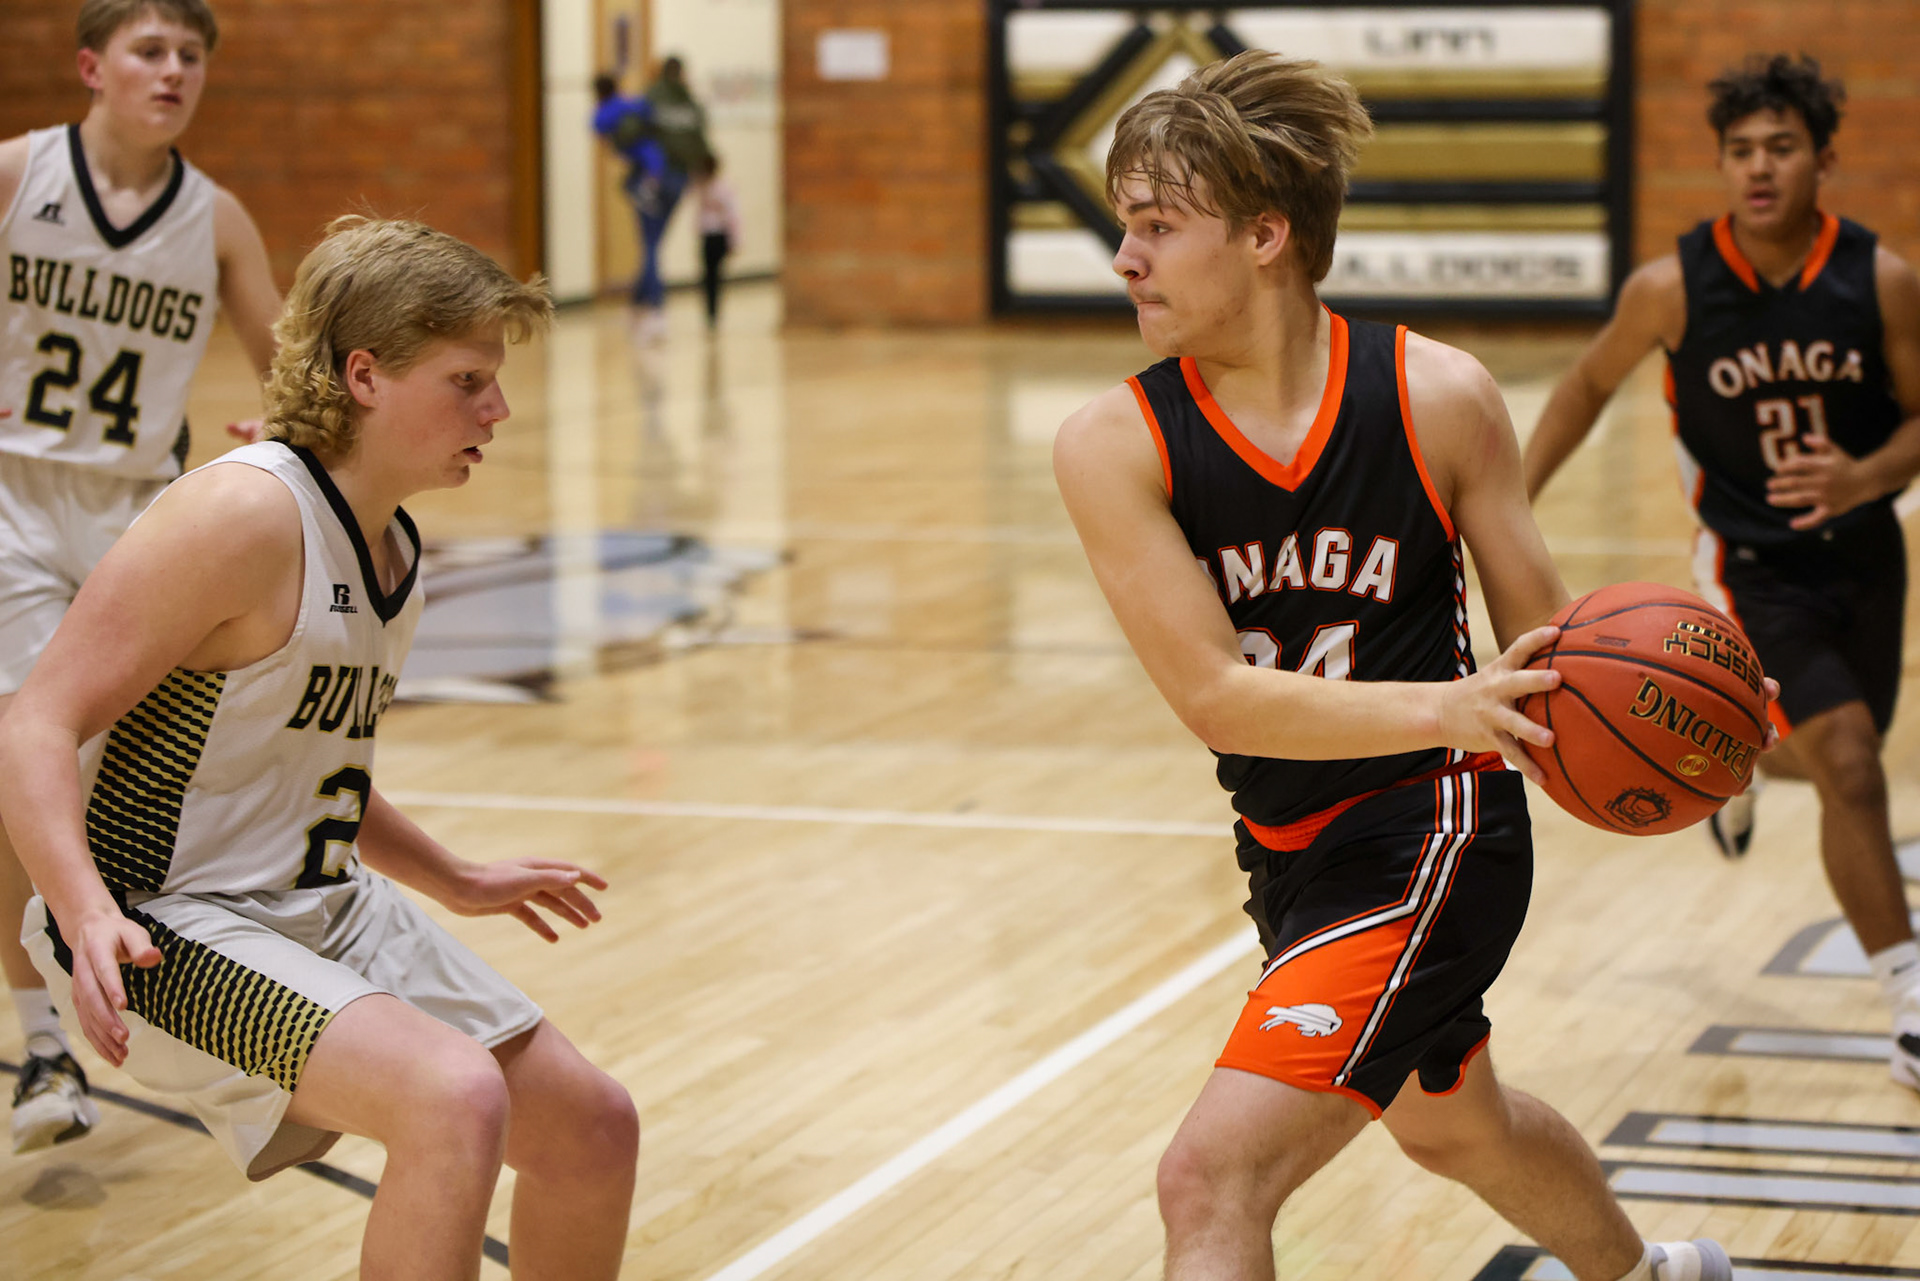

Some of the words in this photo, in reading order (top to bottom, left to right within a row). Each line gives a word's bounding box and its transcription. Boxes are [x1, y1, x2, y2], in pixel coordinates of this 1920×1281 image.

[8, 254, 203, 343] BULLDOGS
[24, 331, 144, 448] 24
[1708, 339, 1865, 398] ONAGA
[1755, 393, 1829, 472] 21
[1663, 632, 1761, 696] EGACY
[1627, 677, 1760, 782] PALDING
